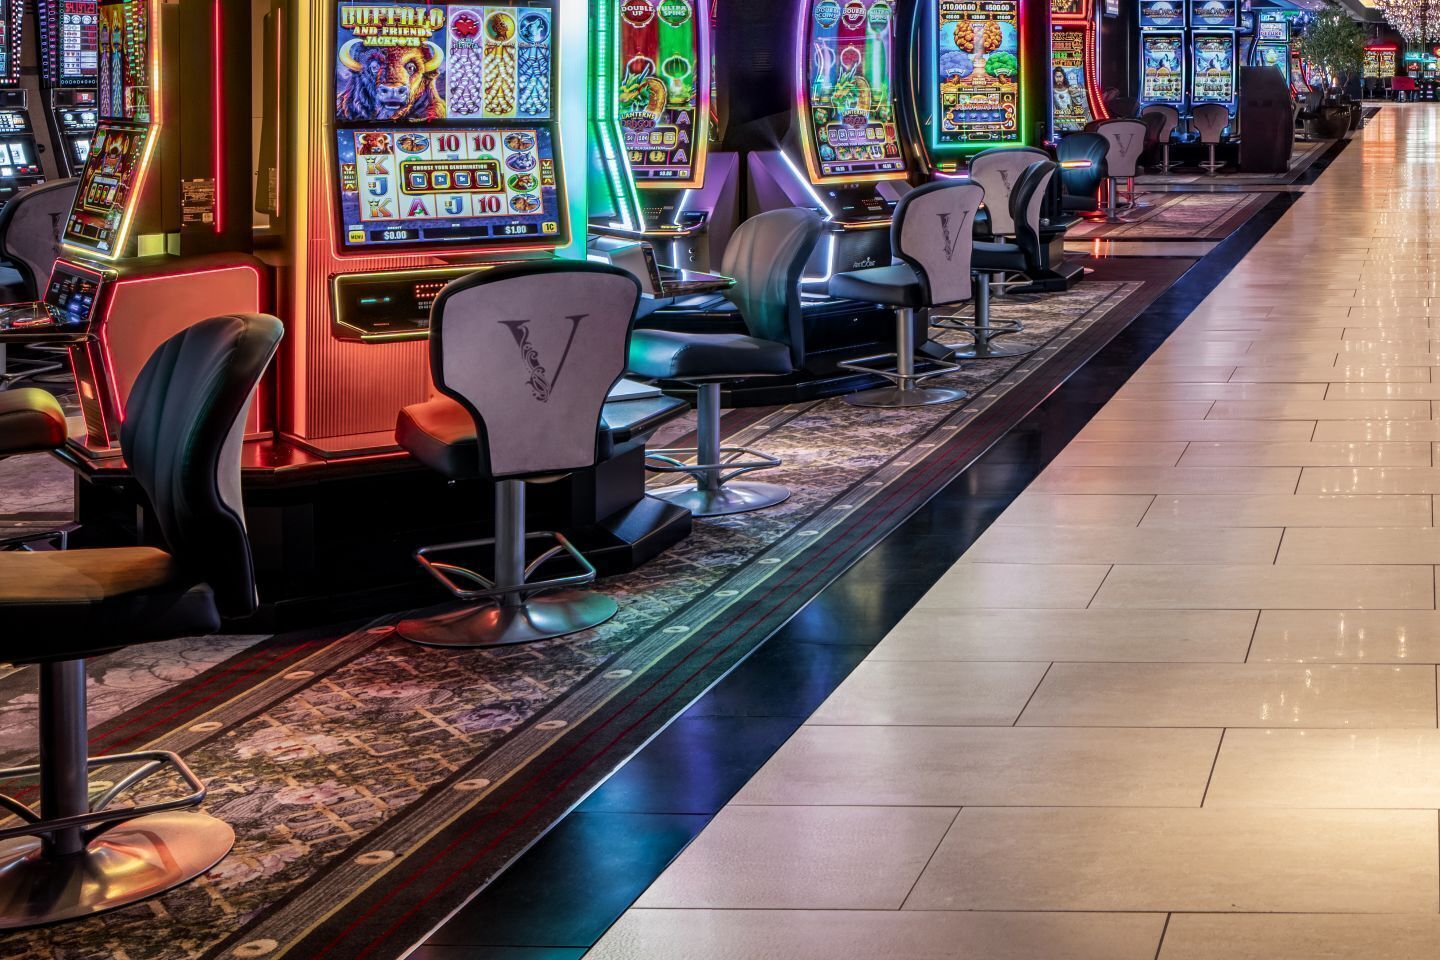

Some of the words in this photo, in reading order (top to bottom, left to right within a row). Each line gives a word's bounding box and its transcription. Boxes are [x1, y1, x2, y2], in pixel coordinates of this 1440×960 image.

[341, 6, 445, 29] BUFFALO
[353, 26, 378, 36] AND
[382, 27, 432, 37] FRIENDS
[505, 225, 527, 234] $1.00
[384, 231, 407, 240] $0.00
[498, 313, 590, 403] V
